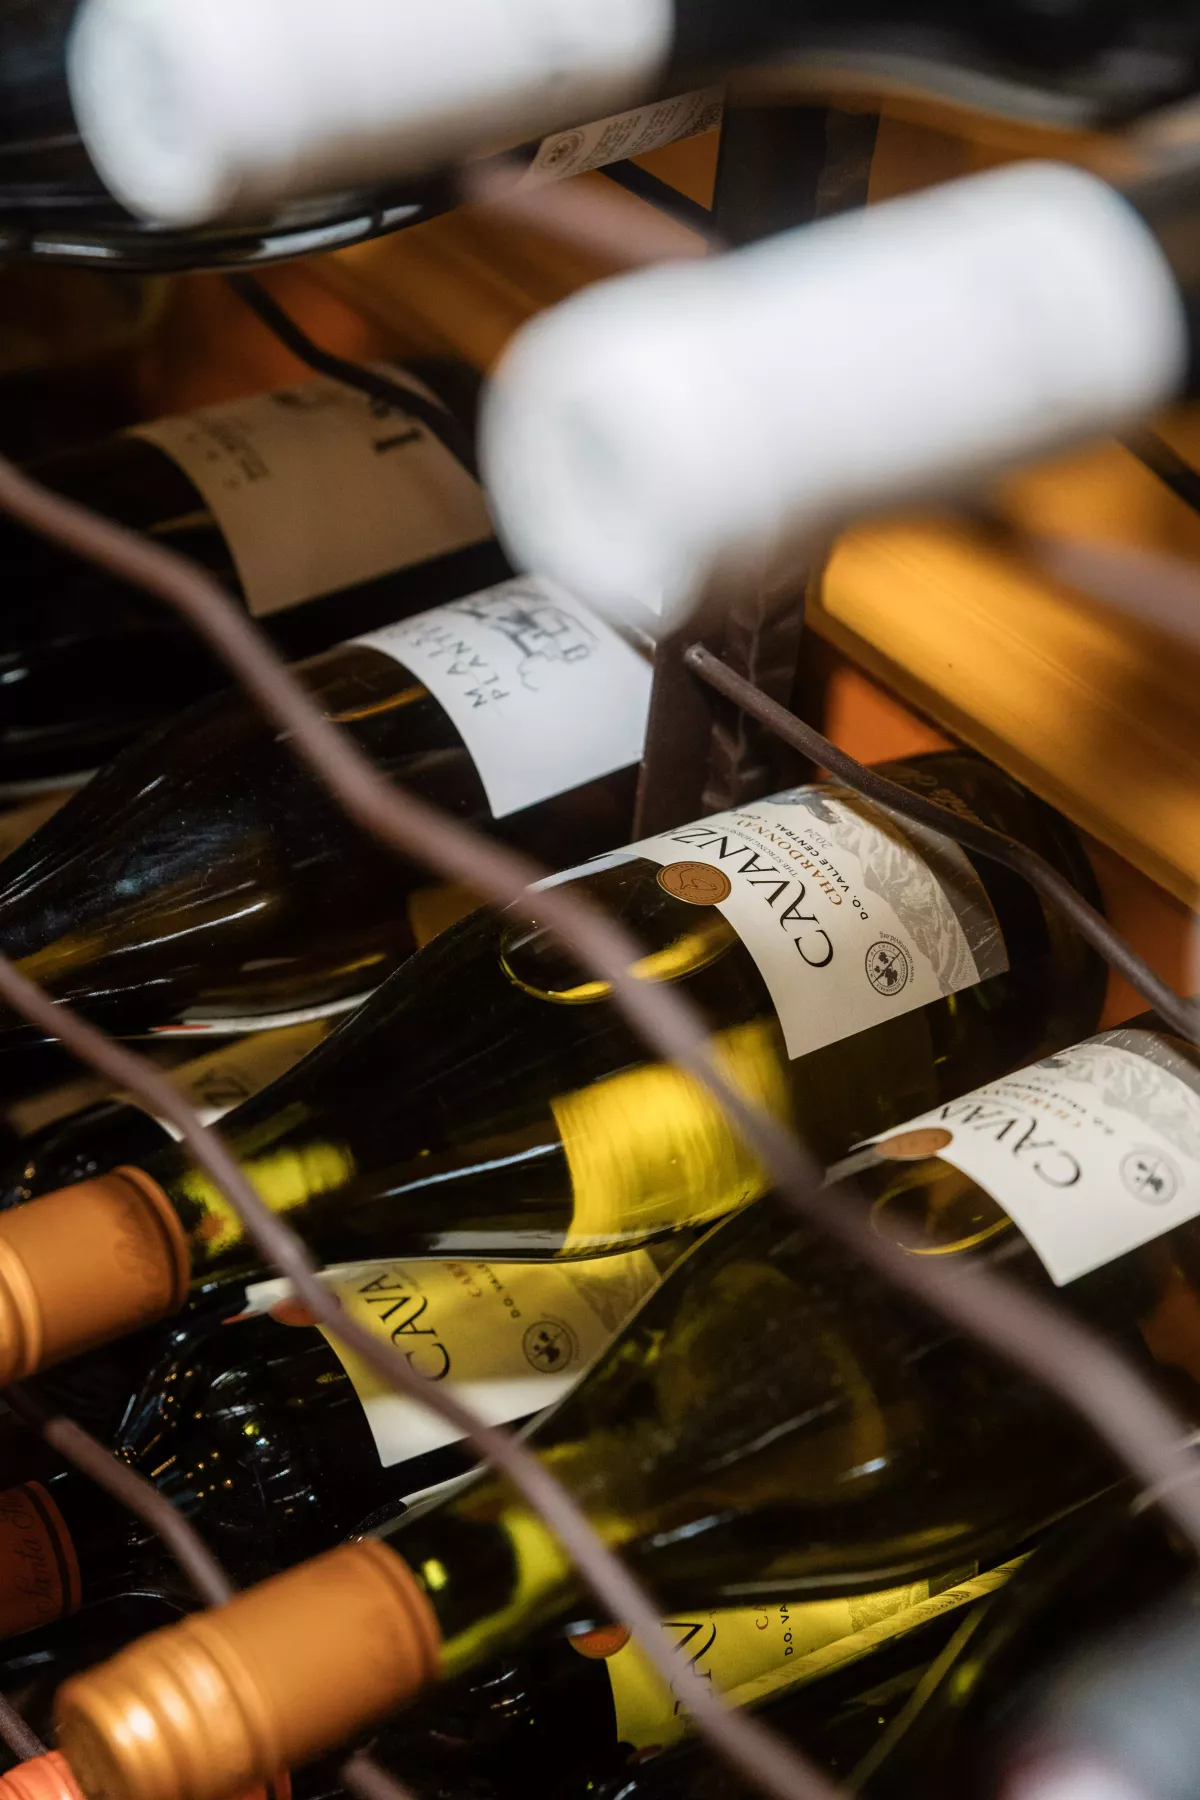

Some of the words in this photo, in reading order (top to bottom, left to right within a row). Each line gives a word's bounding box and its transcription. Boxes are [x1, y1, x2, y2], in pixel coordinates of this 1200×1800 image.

[752, 840, 784, 864] STRONG
[775, 823, 820, 857] CENTRAL
[803, 828, 834, 850] 2024
[734, 819, 843, 906] CHARDONNAY
[781, 862, 798, 878] THE
[818, 858, 850, 893] VALLE
[852, 895, 869, 921] D.O.
[358, 1273, 450, 1382] CAVA
[784, 1627, 794, 1656] D.O.
